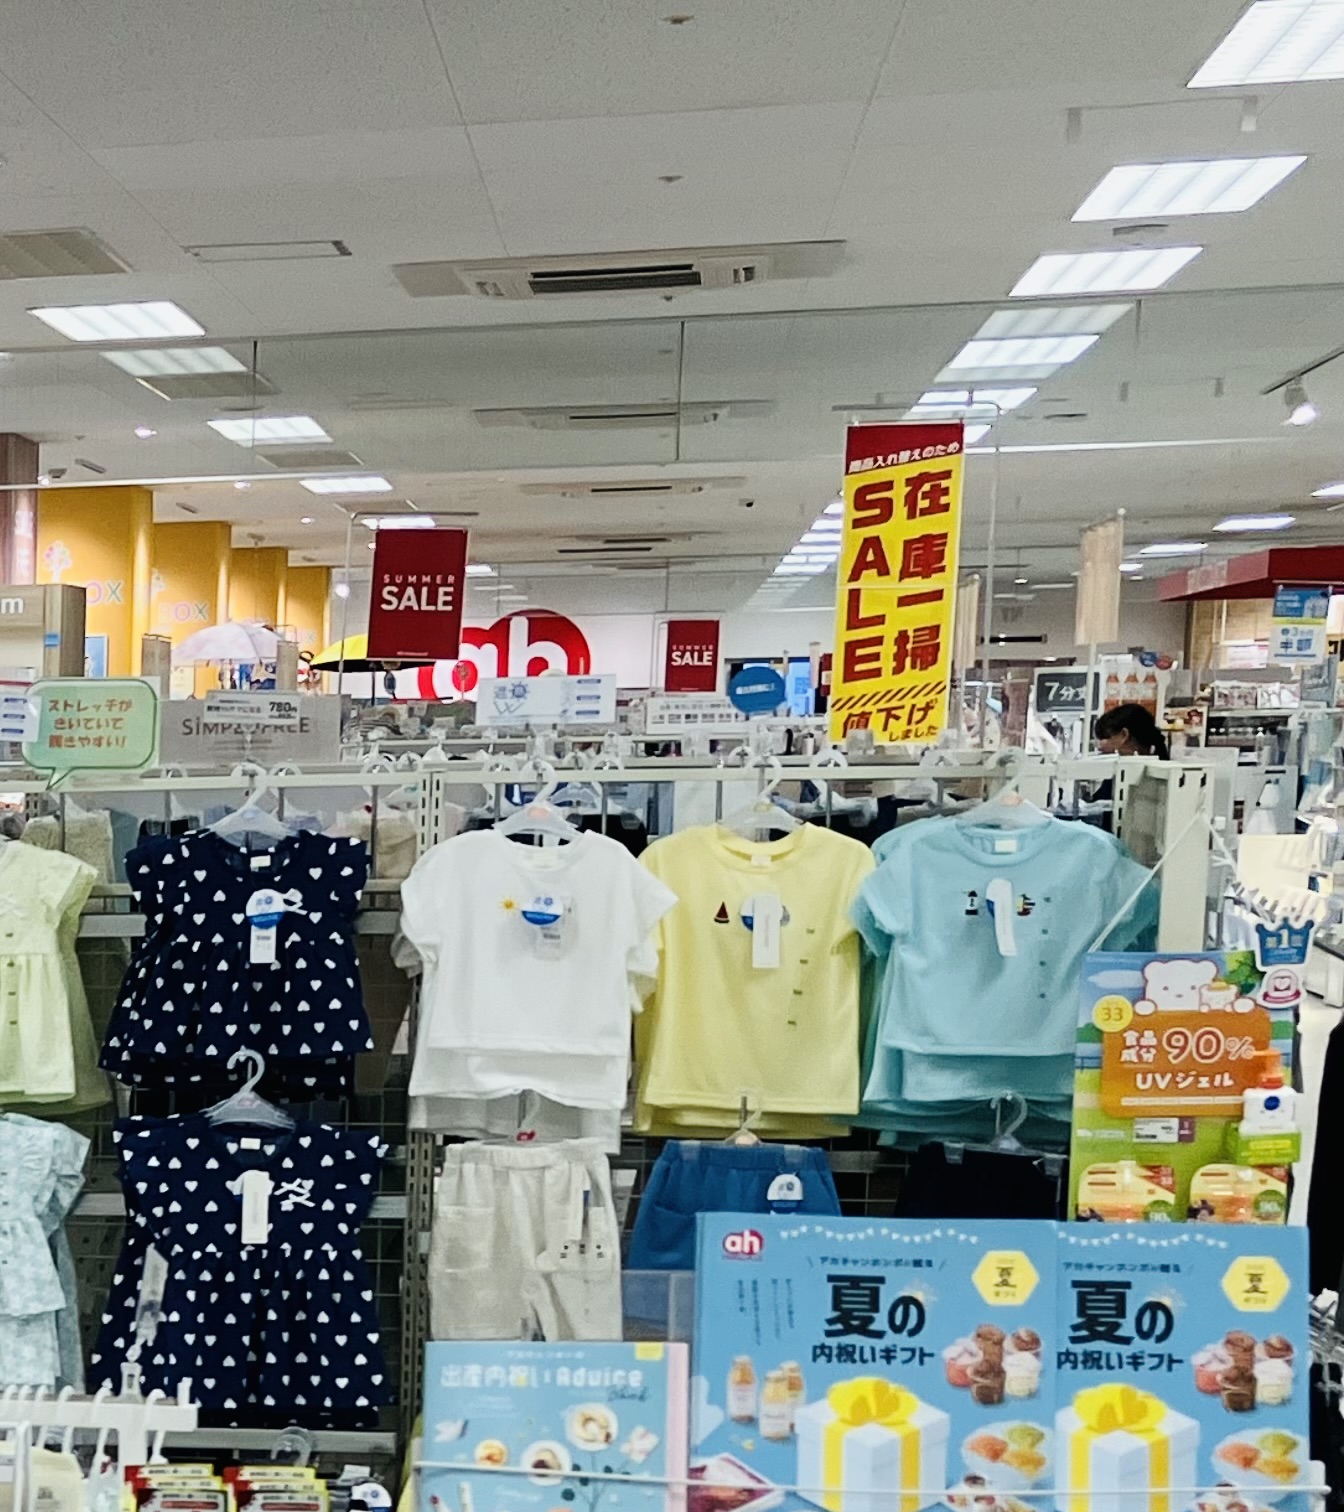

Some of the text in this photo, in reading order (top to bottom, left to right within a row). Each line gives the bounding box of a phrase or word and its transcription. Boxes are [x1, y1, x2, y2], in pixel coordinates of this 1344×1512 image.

[383, 574, 455, 584] SUMMER
[842, 479, 895, 684] SALE
[891, 469, 953, 677] 在庫一掃
[86, 580, 124, 605] OX
[380, 585, 454, 612] SALE
[671, 651, 713, 666] SALE
[1162, 1026, 1257, 1065] 90%
[1135, 1070, 1235, 1090] UVジェル
[723, 1230, 762, 1255] ah
[824, 1273, 926, 1340] 夏の
[1068, 1279, 1175, 1346] 夏の
[811, 1343, 935, 1366] 内祝いギフト
[1056, 1350, 1185, 1373] 内祝いギフト
